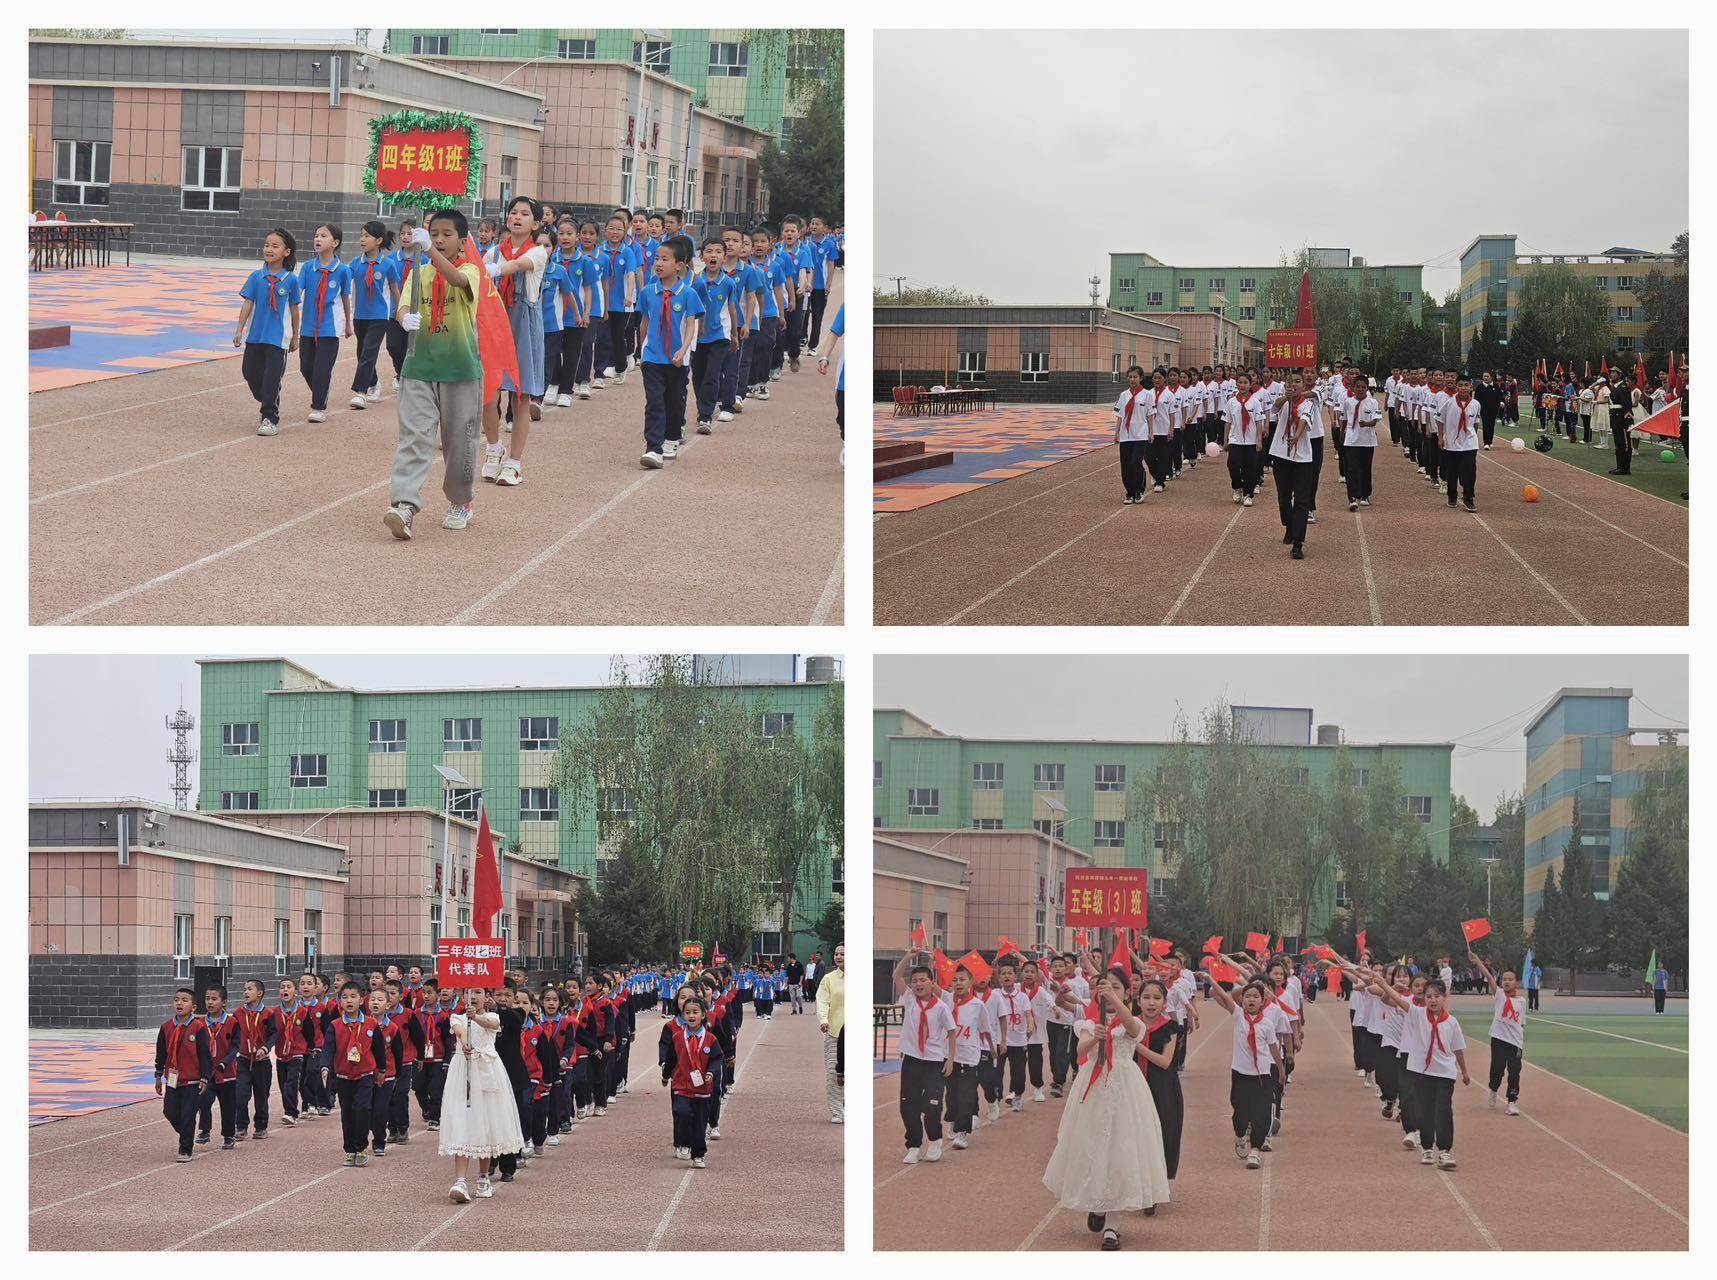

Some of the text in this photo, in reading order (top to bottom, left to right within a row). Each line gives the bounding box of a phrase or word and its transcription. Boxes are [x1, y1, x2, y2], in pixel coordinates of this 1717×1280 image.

[381, 143, 464, 172] 四年级1班
[1268, 343, 1315, 360] 七年级(6)班
[1070, 887, 1142, 916] 五年级（3）班
[438, 944, 502, 958] 三年级七班
[448, 962, 490, 976] 代表队
[955, 1024, 971, 1040] 74
